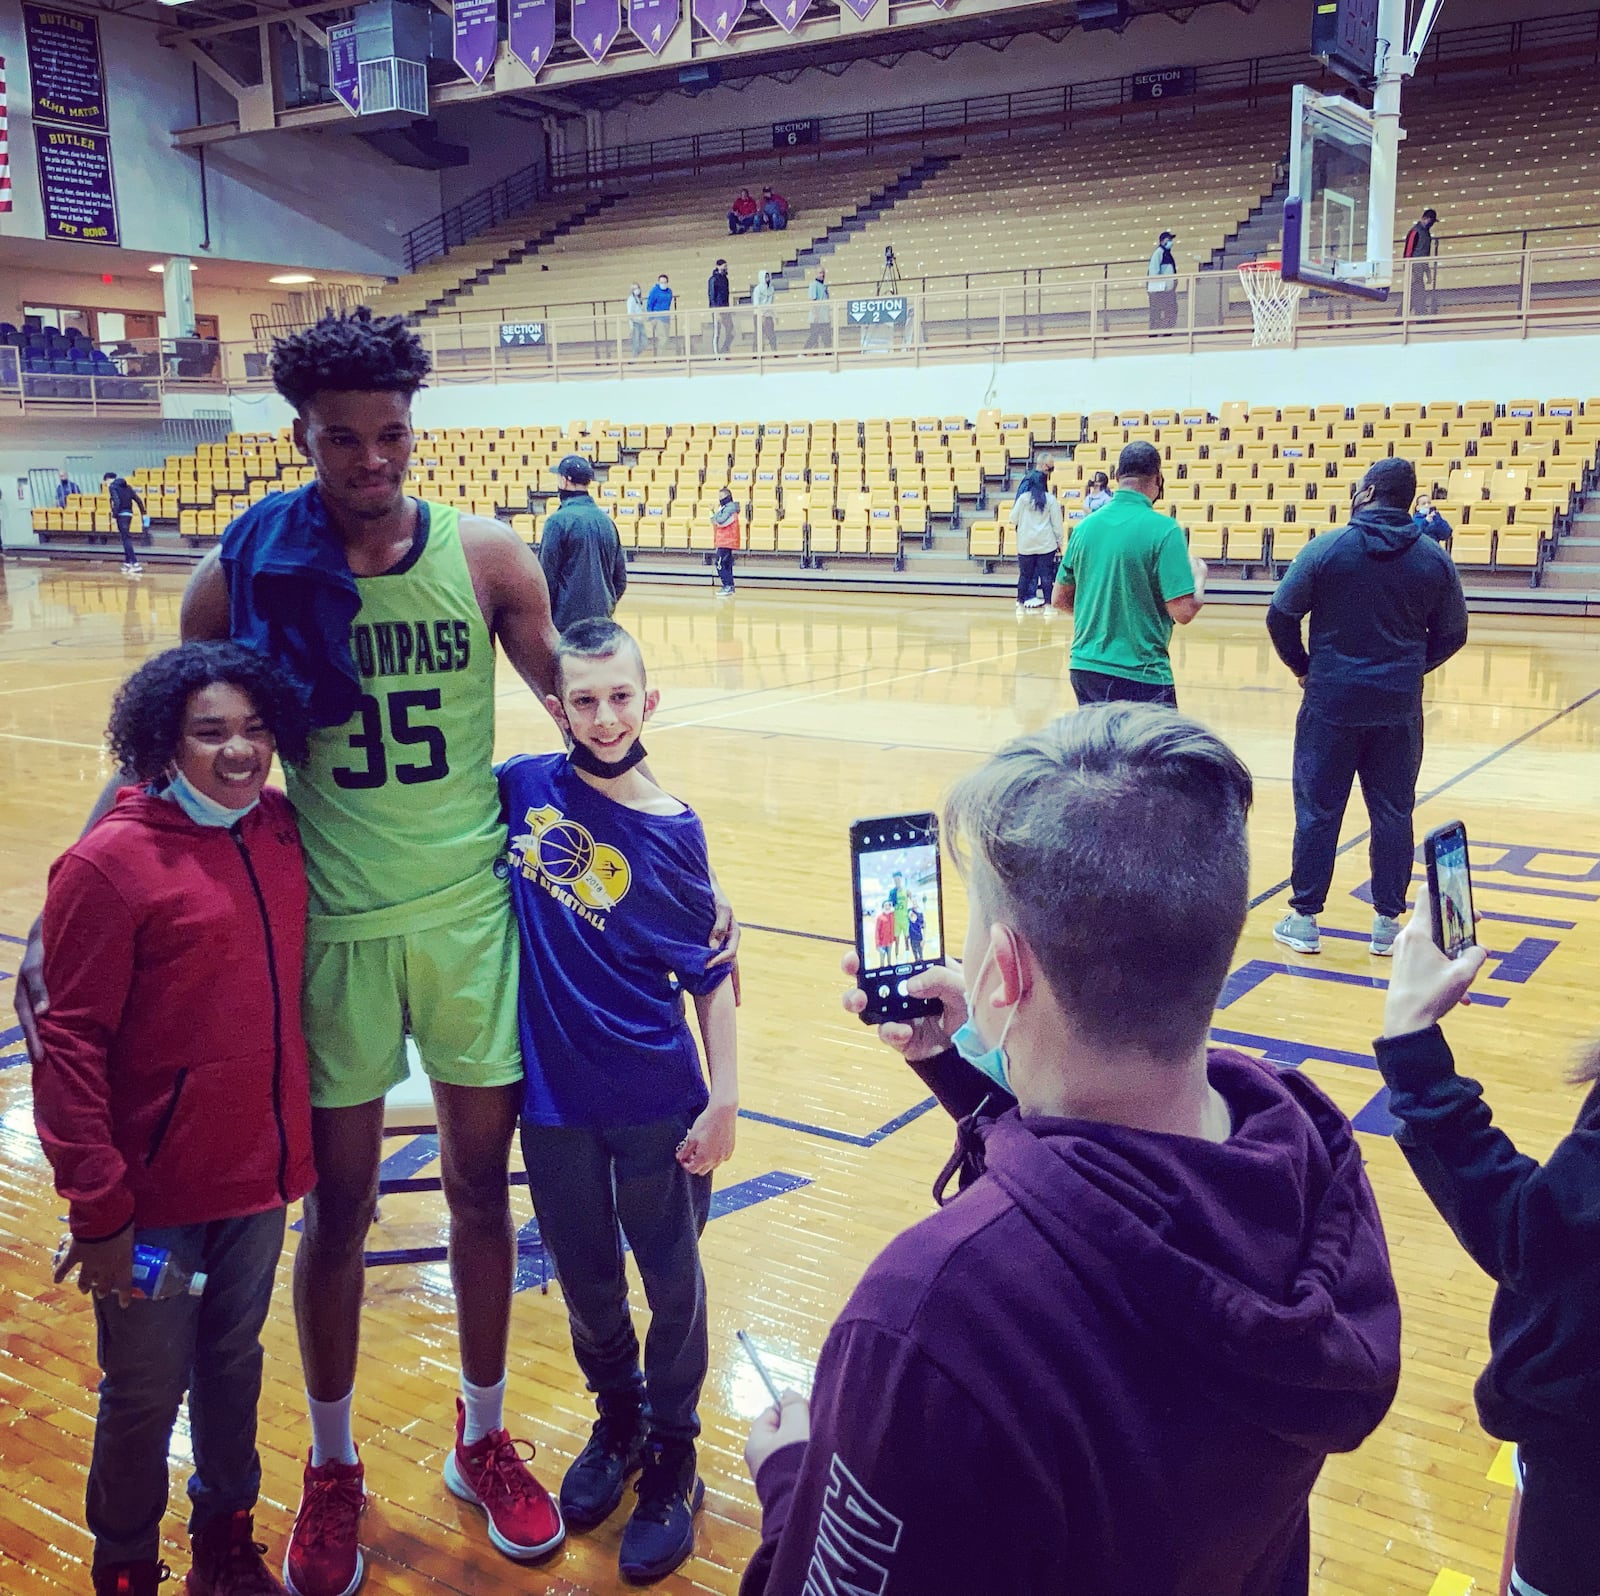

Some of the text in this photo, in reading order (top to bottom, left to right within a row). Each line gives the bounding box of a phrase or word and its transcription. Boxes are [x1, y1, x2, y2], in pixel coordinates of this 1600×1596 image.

[39, 13, 84, 32] BUTLER
[1135, 71, 1180, 84] SECTION
[1151, 83, 1163, 97] 6
[39, 97, 99, 117] ALMA MATER
[774, 121, 810, 133] SECTION
[48, 133, 95, 150] BUTLER
[787, 132, 797, 145] 6
[59, 221, 107, 237] PEP SONG
[851, 299, 903, 312] SECTION
[872, 311, 880, 322] 2
[502, 323, 541, 335] SECTION
[519, 334, 525, 345] 2
[353, 619, 471, 678] OMPASS
[332, 688, 449, 789] 35
[585, 875, 603, 893] 2018
